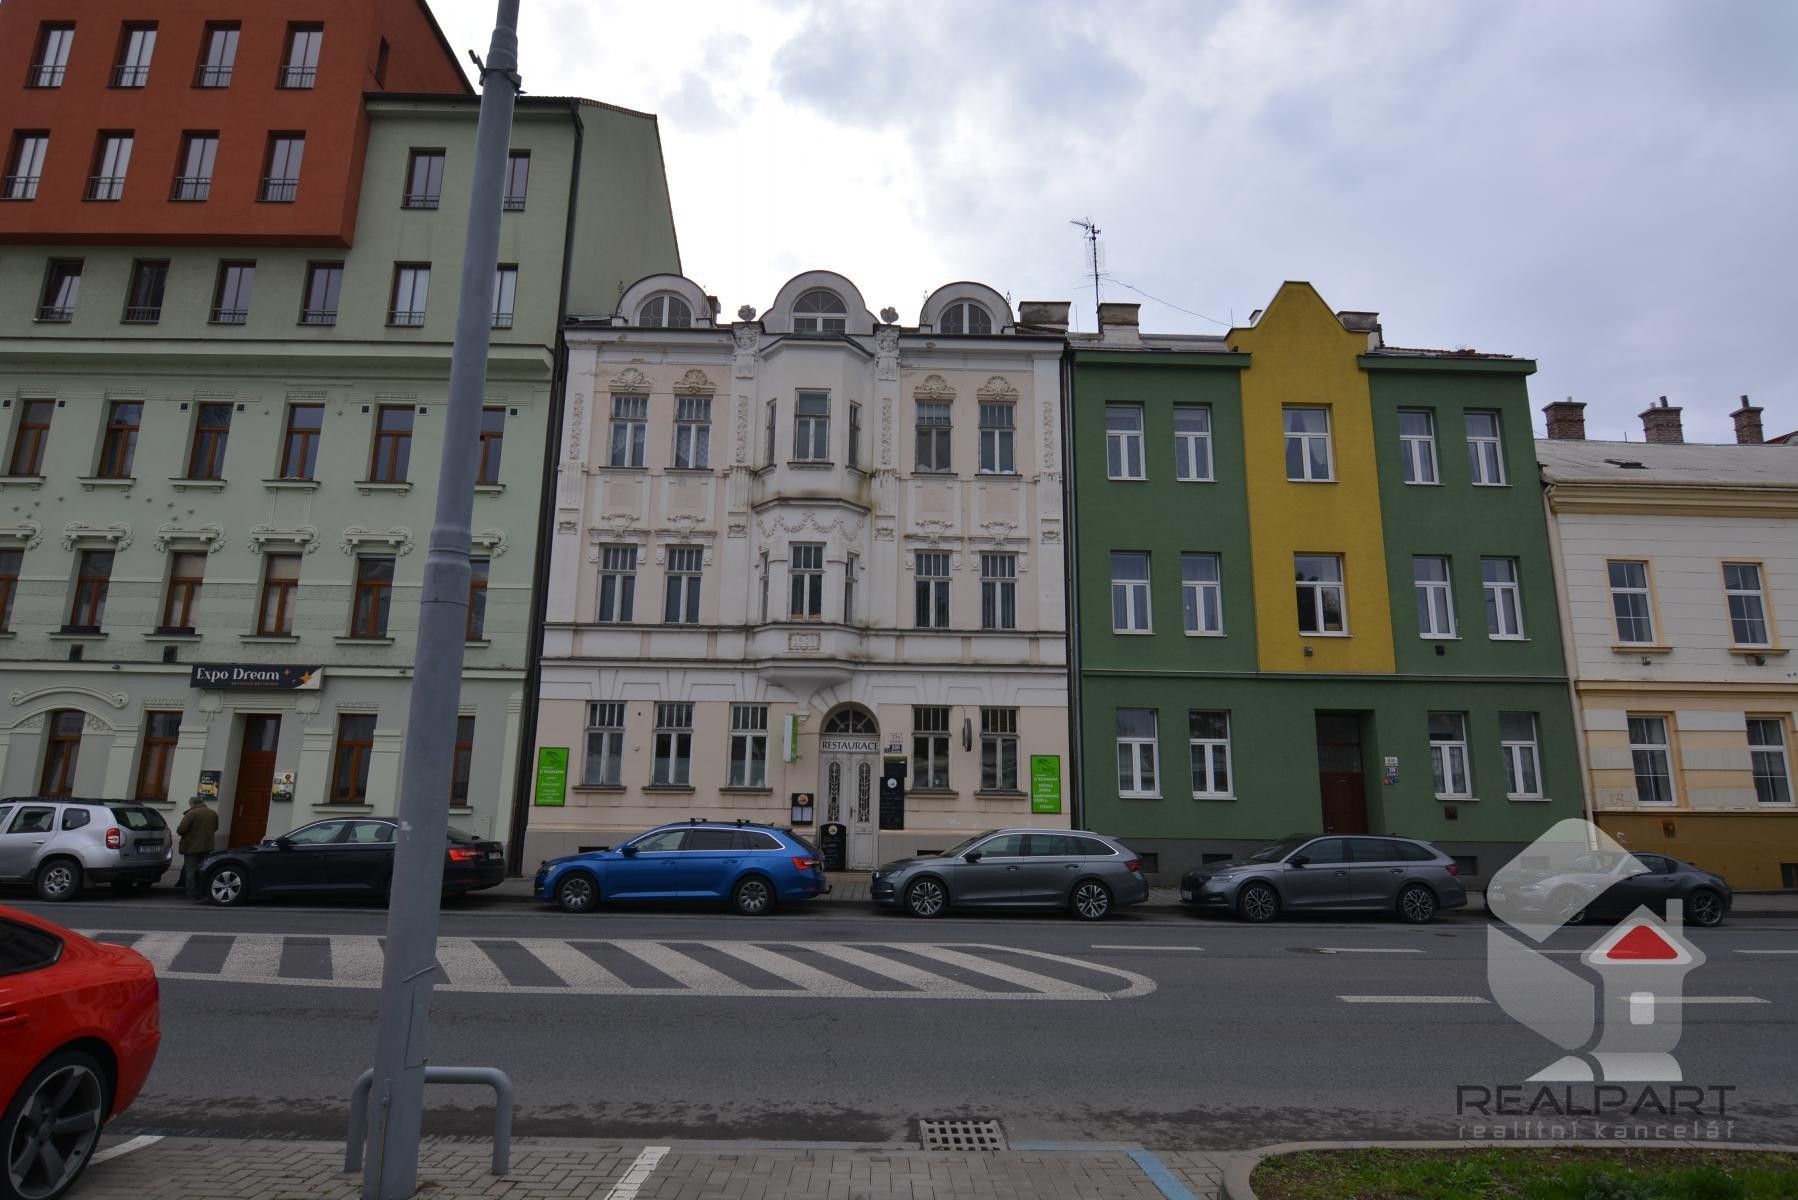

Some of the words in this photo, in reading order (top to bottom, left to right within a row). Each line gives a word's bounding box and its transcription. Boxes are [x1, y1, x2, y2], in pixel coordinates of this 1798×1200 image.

[196, 667, 229, 682] Expo
[232, 667, 280, 680] Dream
[822, 741, 880, 750] RESTAURACE
